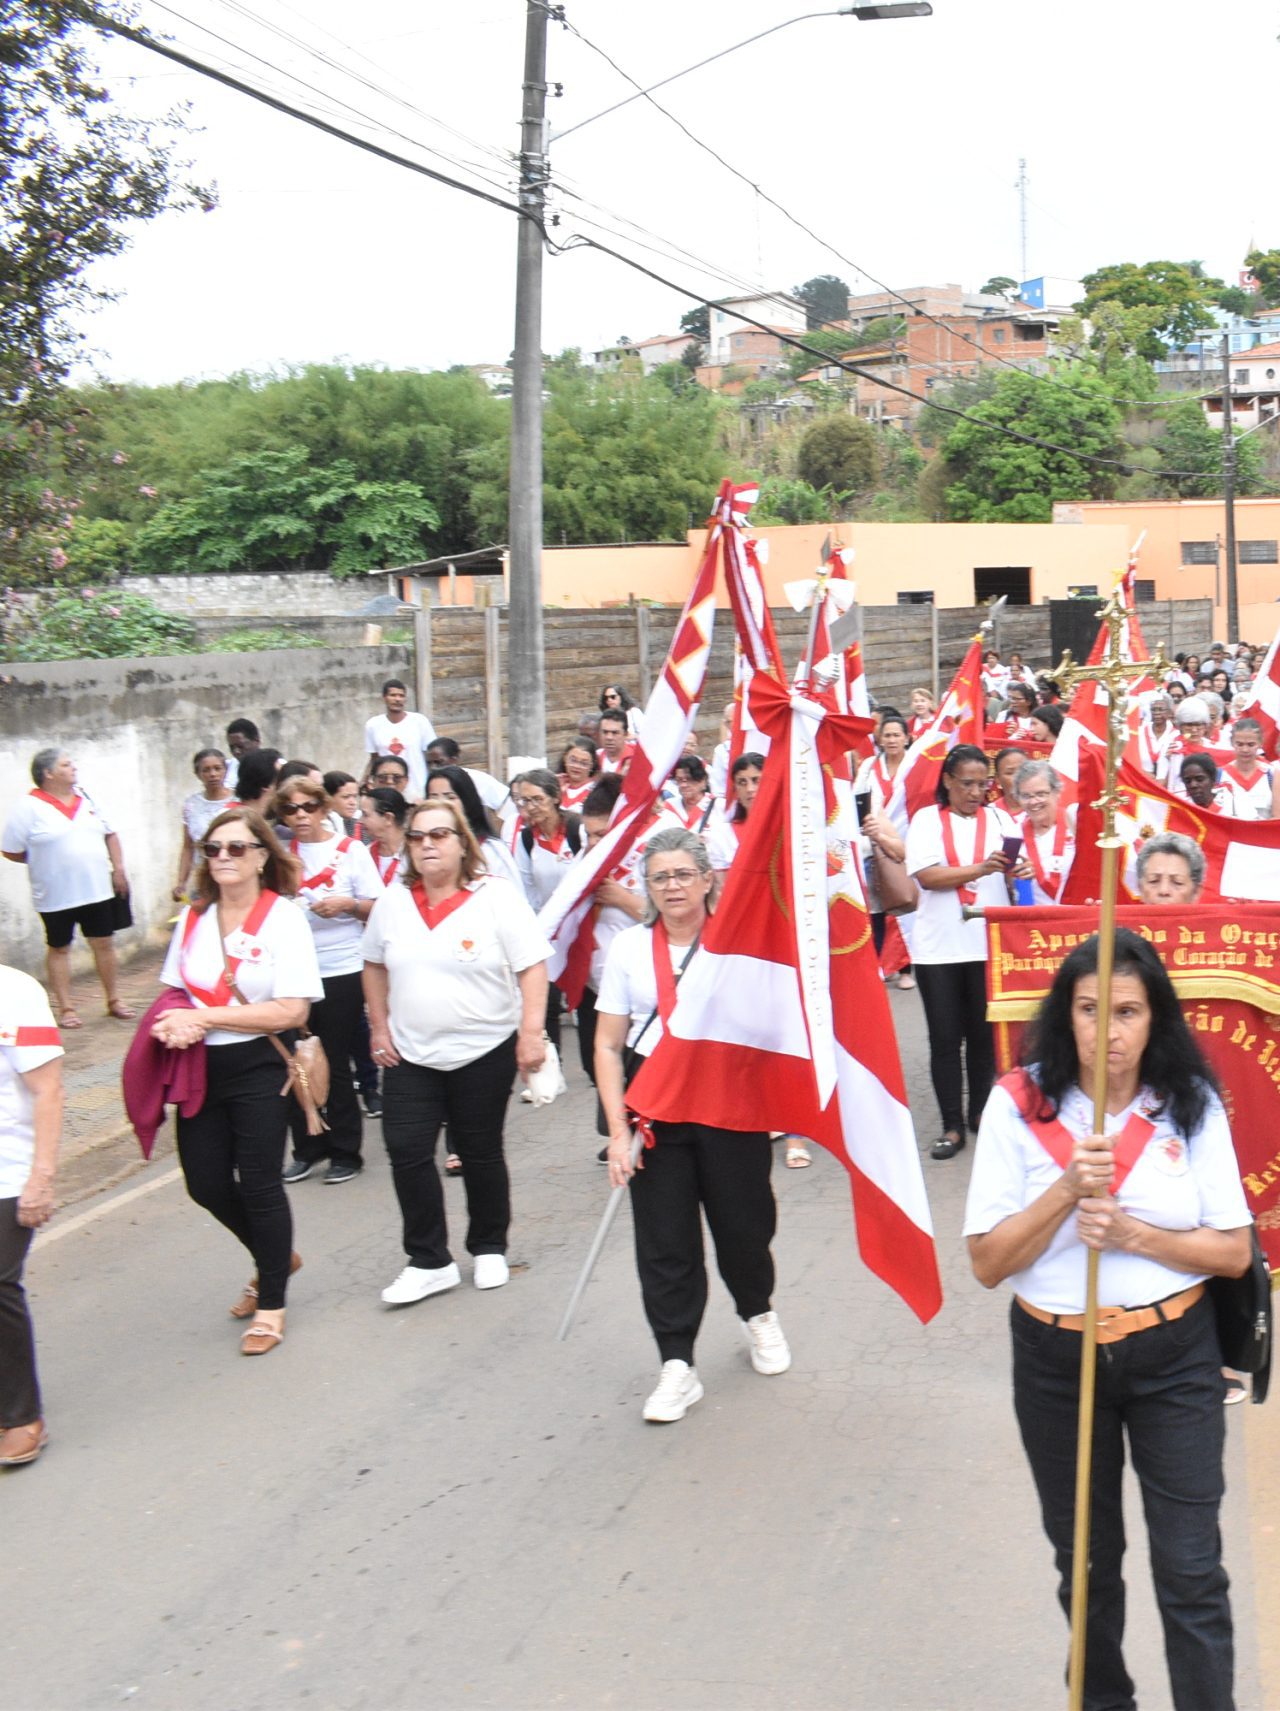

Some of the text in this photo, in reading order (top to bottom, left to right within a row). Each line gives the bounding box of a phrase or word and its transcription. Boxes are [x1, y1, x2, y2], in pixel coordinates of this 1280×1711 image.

[1028, 925, 1167, 952] Aposdo
[1178, 925, 1206, 944] da
[1173, 945, 1248, 969] Coração
[1254, 949, 1274, 968] de
[1229, 1020, 1258, 1052] de
